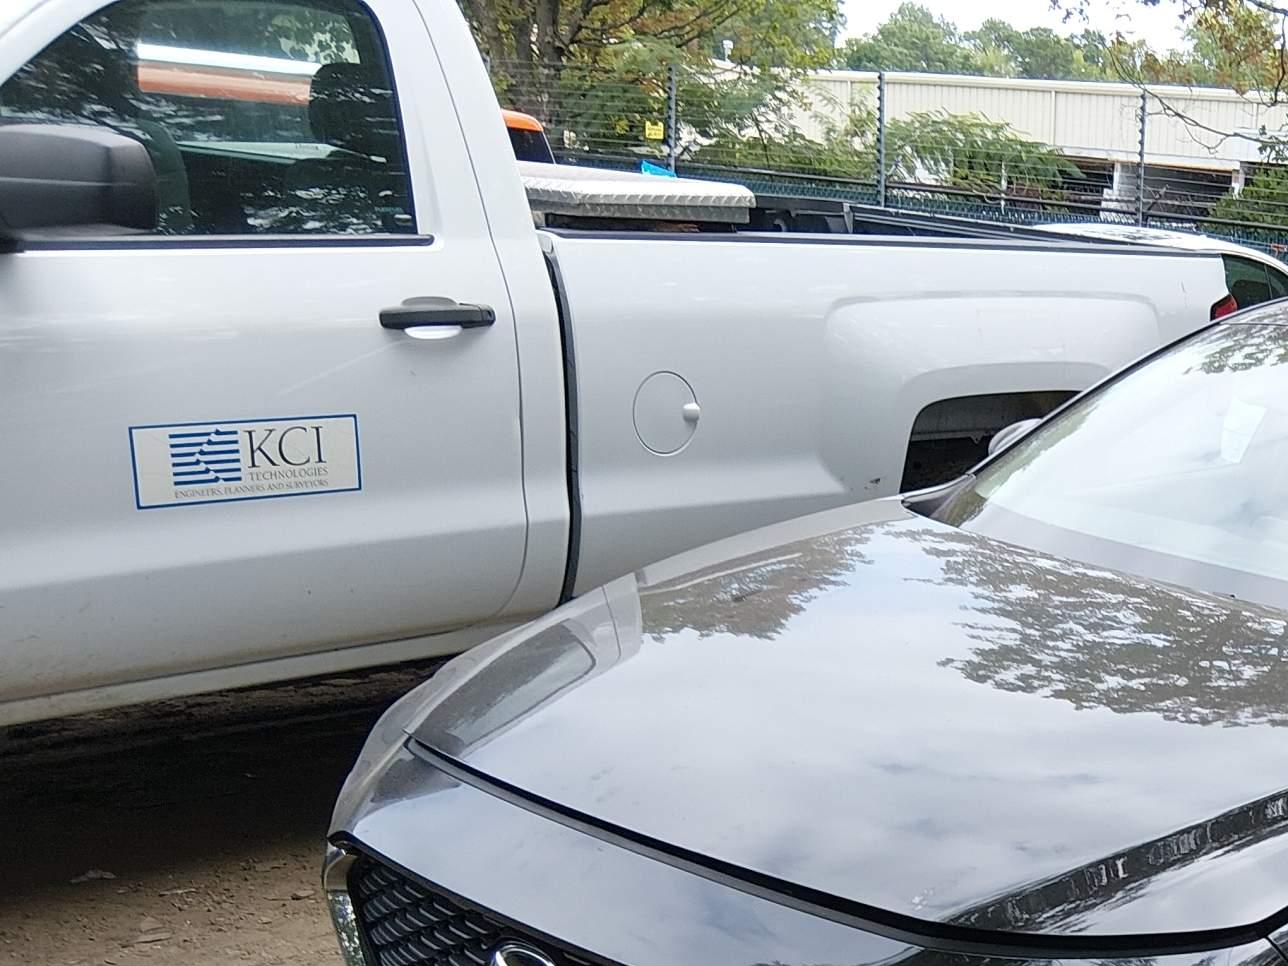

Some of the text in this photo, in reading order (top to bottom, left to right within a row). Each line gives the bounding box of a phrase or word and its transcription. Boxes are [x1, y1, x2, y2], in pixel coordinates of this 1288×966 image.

[243, 425, 327, 469] KCI
[248, 466, 329, 482] TECHNOLOGIES
[267, 481, 285, 492] AND
[285, 478, 329, 490] SURVEYORS
